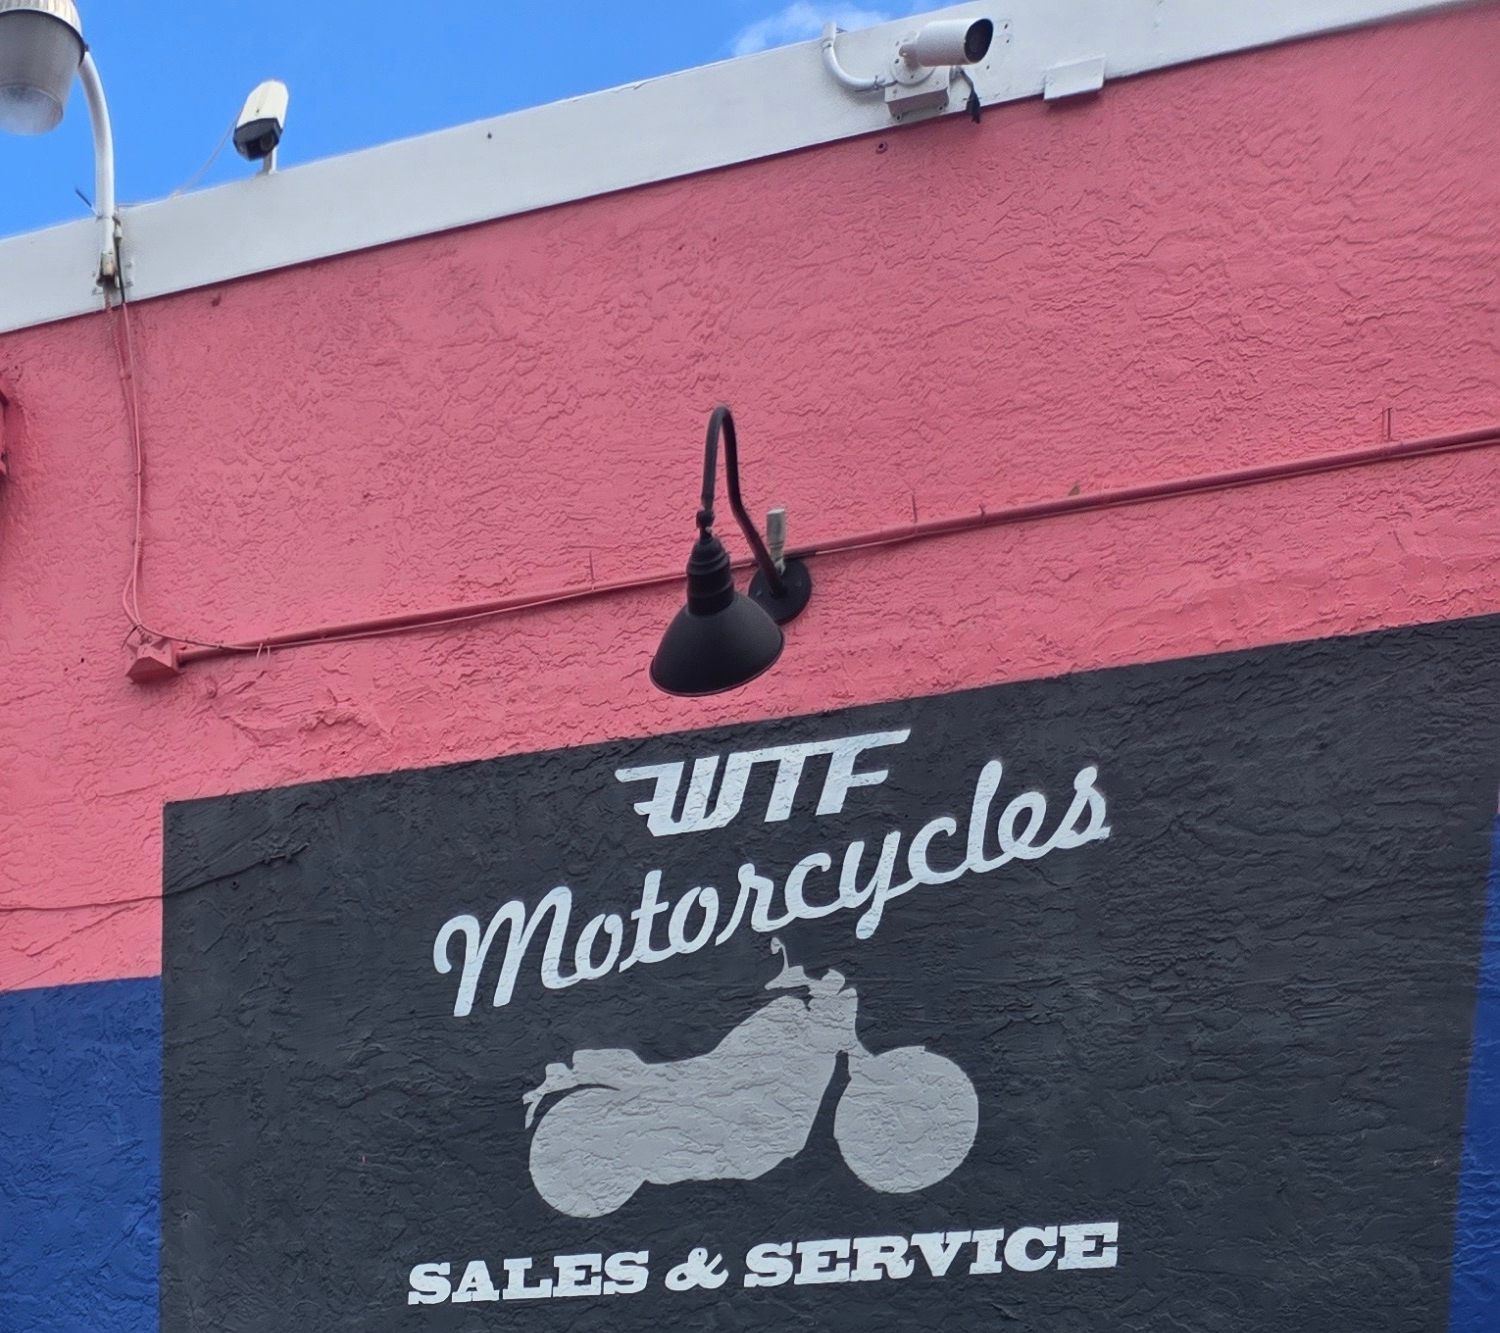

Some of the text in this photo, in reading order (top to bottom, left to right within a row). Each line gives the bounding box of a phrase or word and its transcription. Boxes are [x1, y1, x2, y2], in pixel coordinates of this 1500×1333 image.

[615, 729, 911, 836] WTF
[433, 760, 1110, 1017] Motorcycles
[407, 1222, 1119, 1305] SALES & SERVICE
